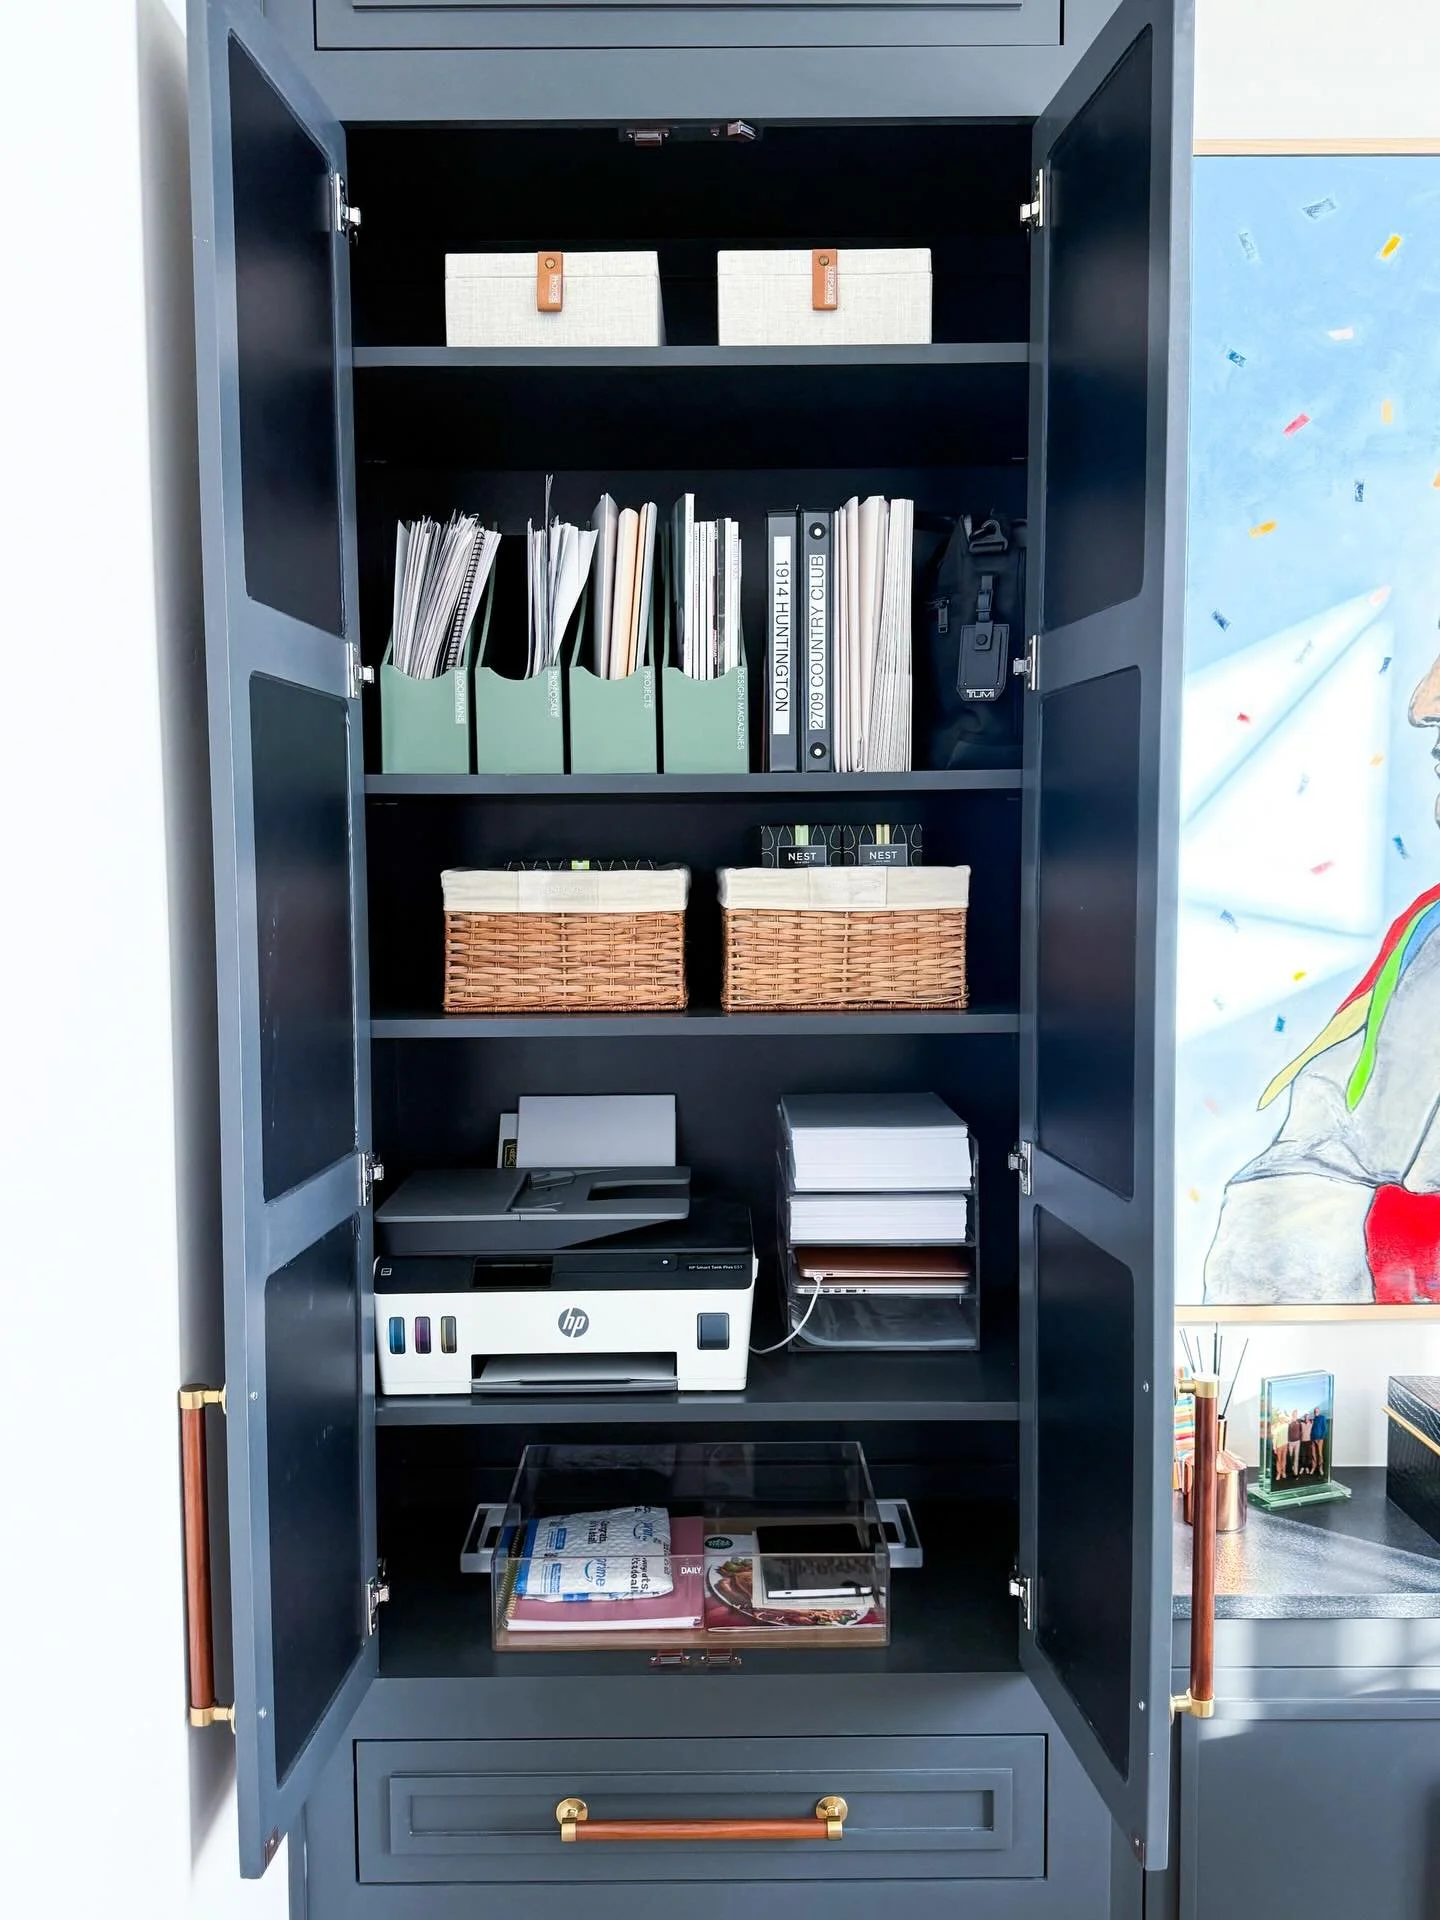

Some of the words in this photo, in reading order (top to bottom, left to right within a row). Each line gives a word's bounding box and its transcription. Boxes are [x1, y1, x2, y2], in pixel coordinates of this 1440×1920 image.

[775, 561, 790, 597] 1914
[810, 556, 825, 600] CLUB
[775, 603, 790, 712] HUNTINGTON
[810, 606, 825, 688] COUNTRY
[643, 671, 652, 708] PROJECTS
[737, 669, 745, 699] DESIGN
[966, 688, 995, 698] TUMI
[737, 702, 745, 750] MAGAZINES
[810, 693, 825, 729] 2709
[788, 852, 817, 861] NEST
[869, 851, 898, 860] NEST
[561, 1307, 587, 1337] hp
[681, 1567, 702, 1575] DAILY
